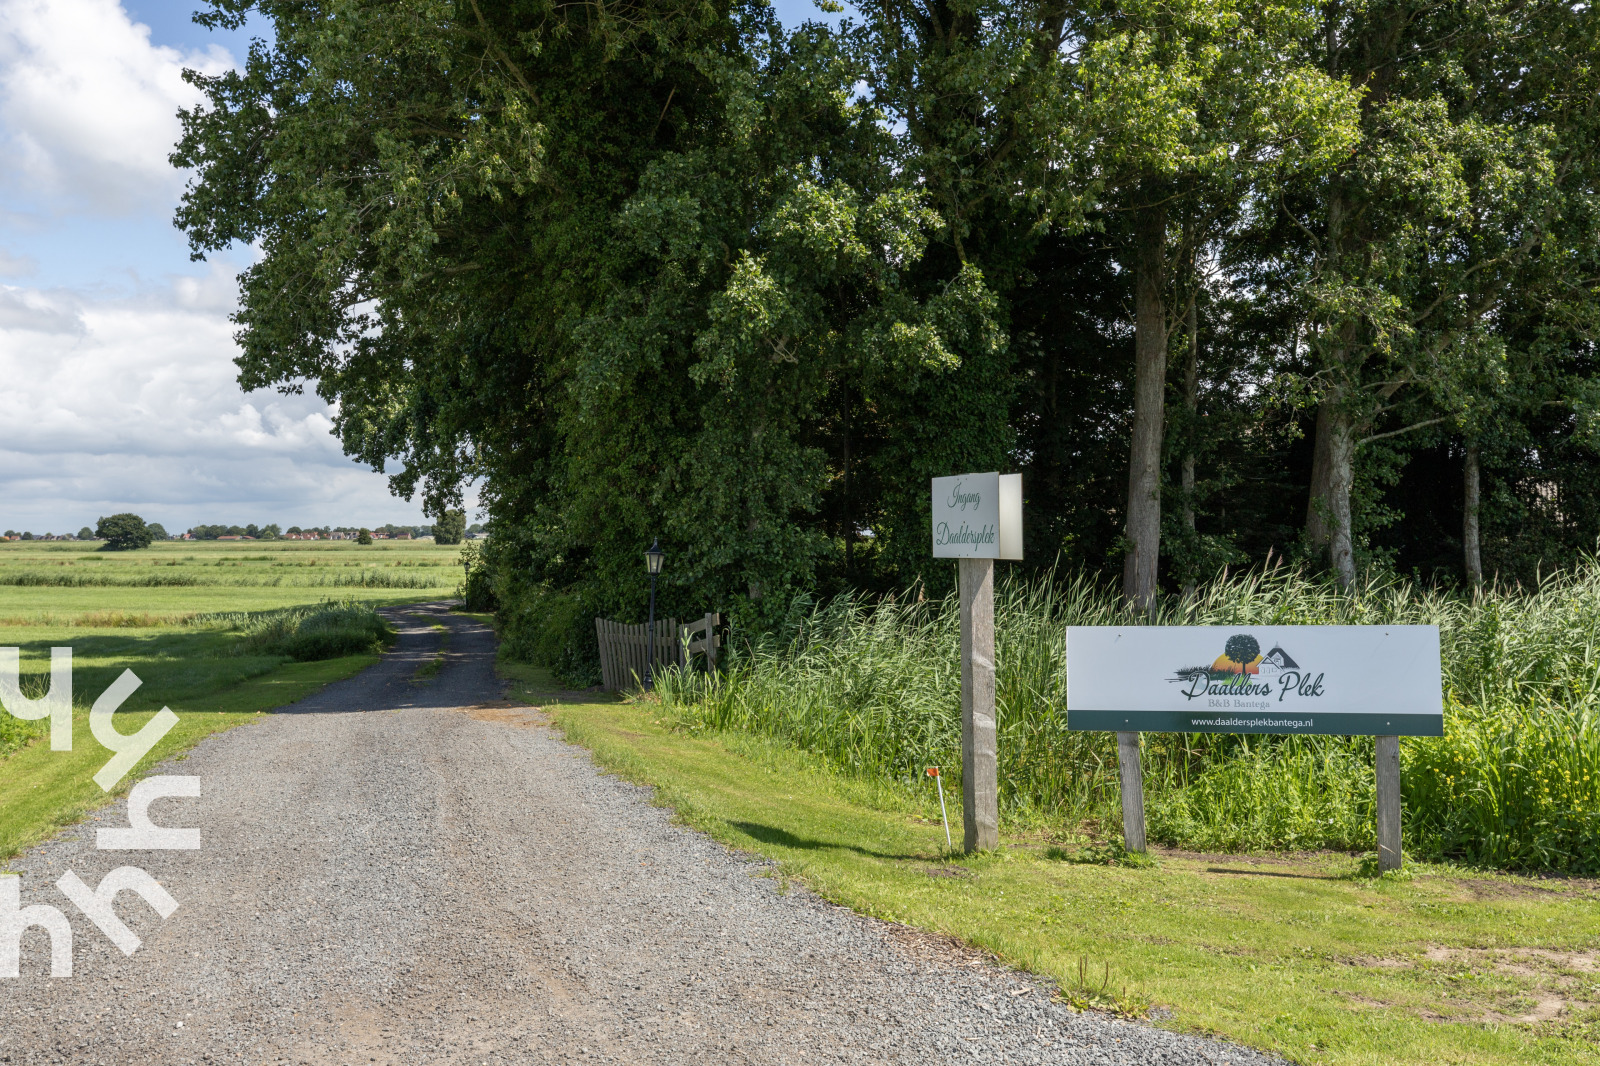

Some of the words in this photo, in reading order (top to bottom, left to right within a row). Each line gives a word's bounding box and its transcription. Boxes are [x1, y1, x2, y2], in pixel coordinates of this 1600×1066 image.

[947, 482, 980, 511] Ingang
[936, 521, 994, 551] Daaldersplek
[1181, 671, 1272, 701] Daalders
[1278, 671, 1325, 701] Plek
[1207, 699, 1231, 708] B&B
[1233, 699, 1271, 710] Bantega
[1191, 717, 1314, 729] www.daaldersplekbantega.nl
